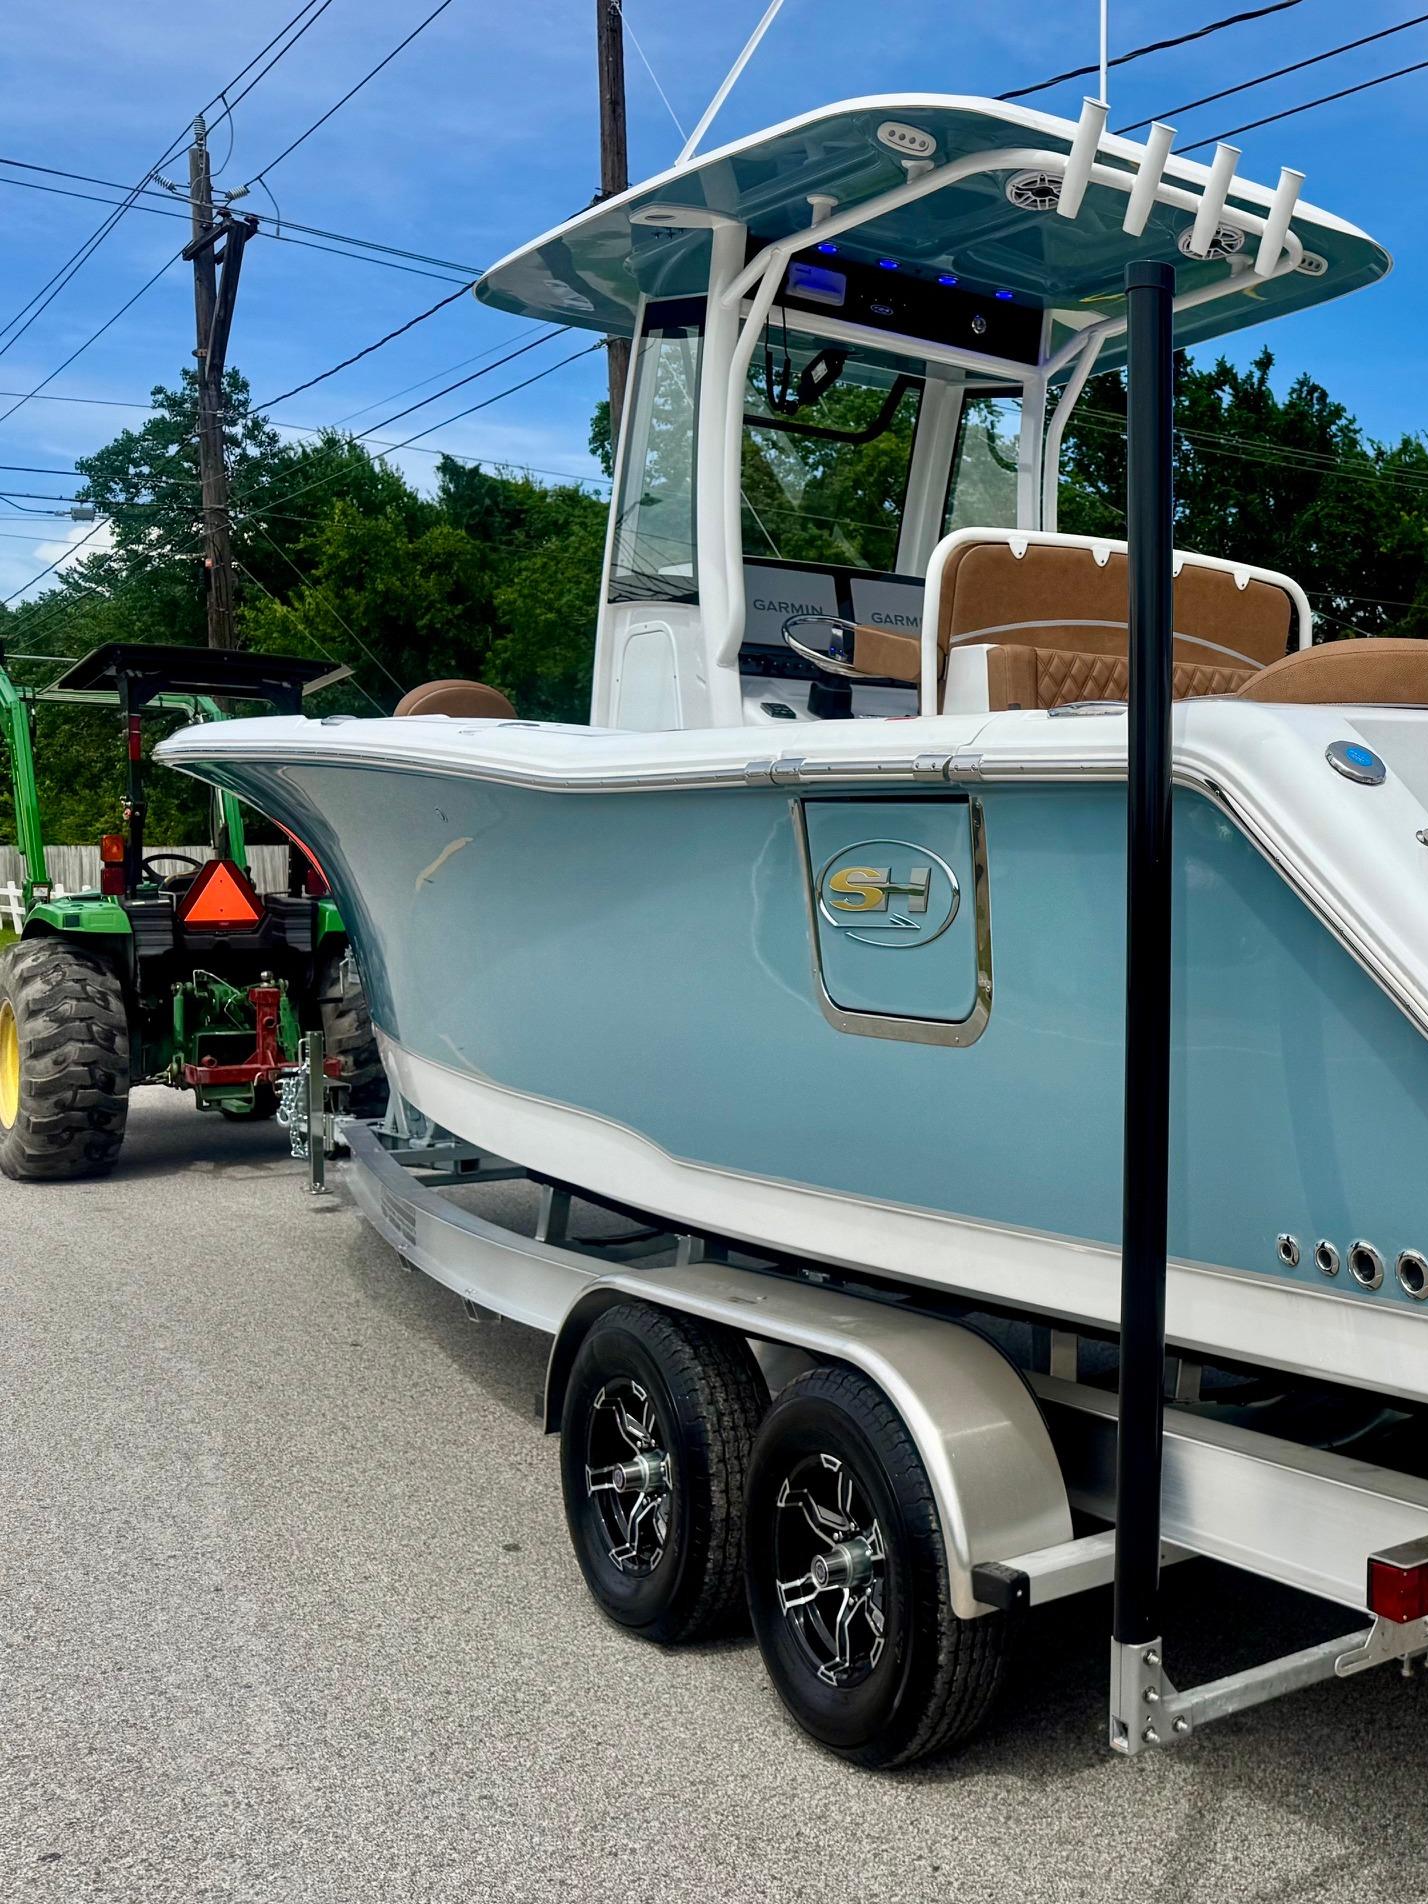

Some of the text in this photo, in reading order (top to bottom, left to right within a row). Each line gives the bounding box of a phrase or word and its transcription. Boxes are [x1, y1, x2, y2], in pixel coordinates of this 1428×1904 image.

[753, 599, 823, 615] GARMIN
[871, 612, 923, 628] GARM
[829, 866, 931, 913] SH
